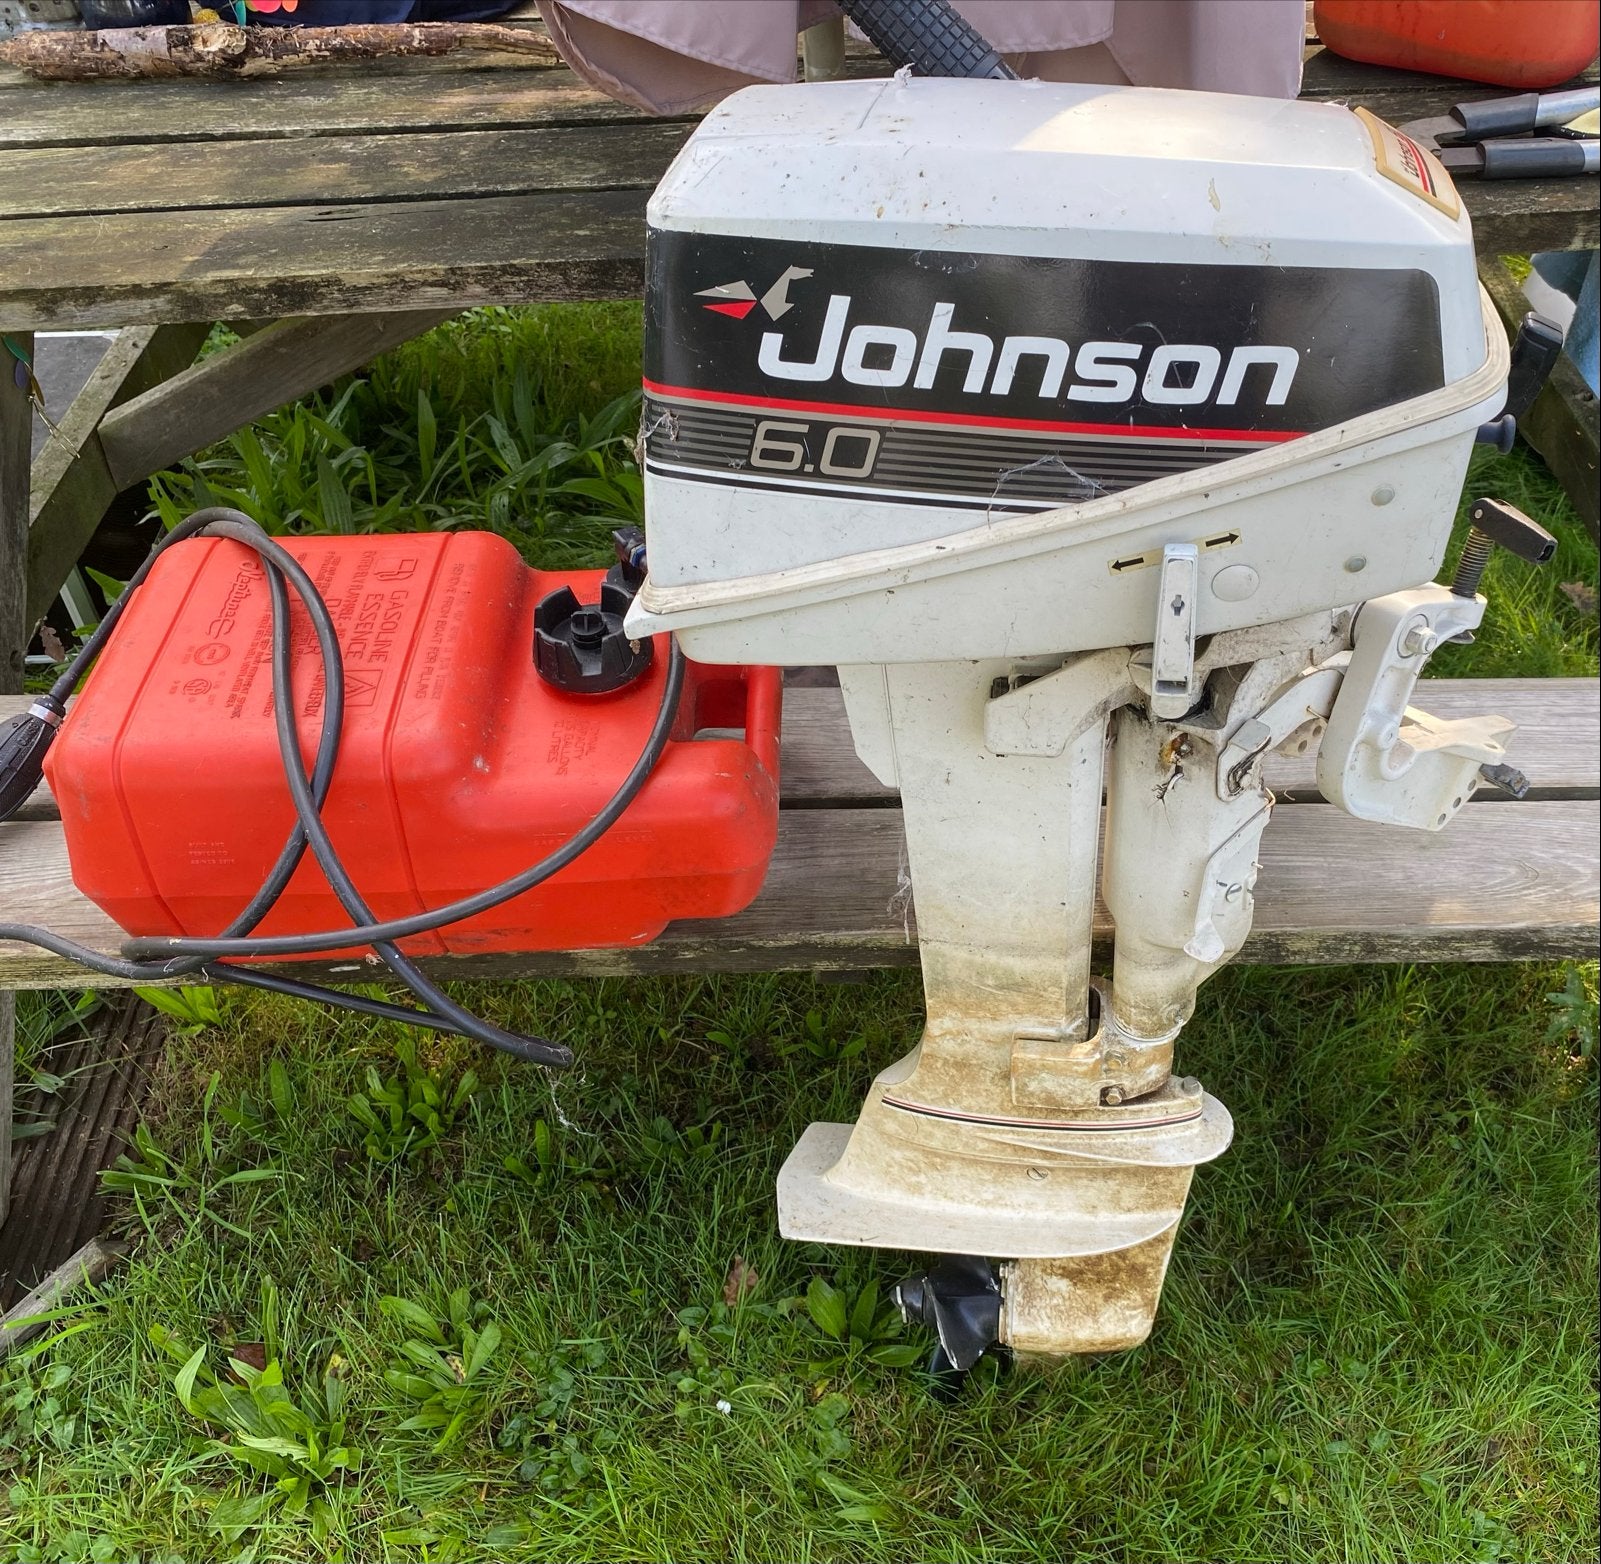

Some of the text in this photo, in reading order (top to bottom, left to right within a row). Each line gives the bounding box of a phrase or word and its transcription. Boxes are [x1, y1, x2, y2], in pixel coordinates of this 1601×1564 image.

[758, 295, 1300, 406] Johnson
[750, 420, 881, 478] 6.0
[344, 593, 385, 661] ESSENCE
[367, 590, 409, 664] GASOLINE
[440, 596, 457, 619] FROM
[431, 619, 448, 645] BOAT
[424, 646, 440, 668] FOR
[415, 666, 435, 700] FILLING
[546, 730, 562, 764] LITRES
[555, 733, 575, 777] GALLONS
